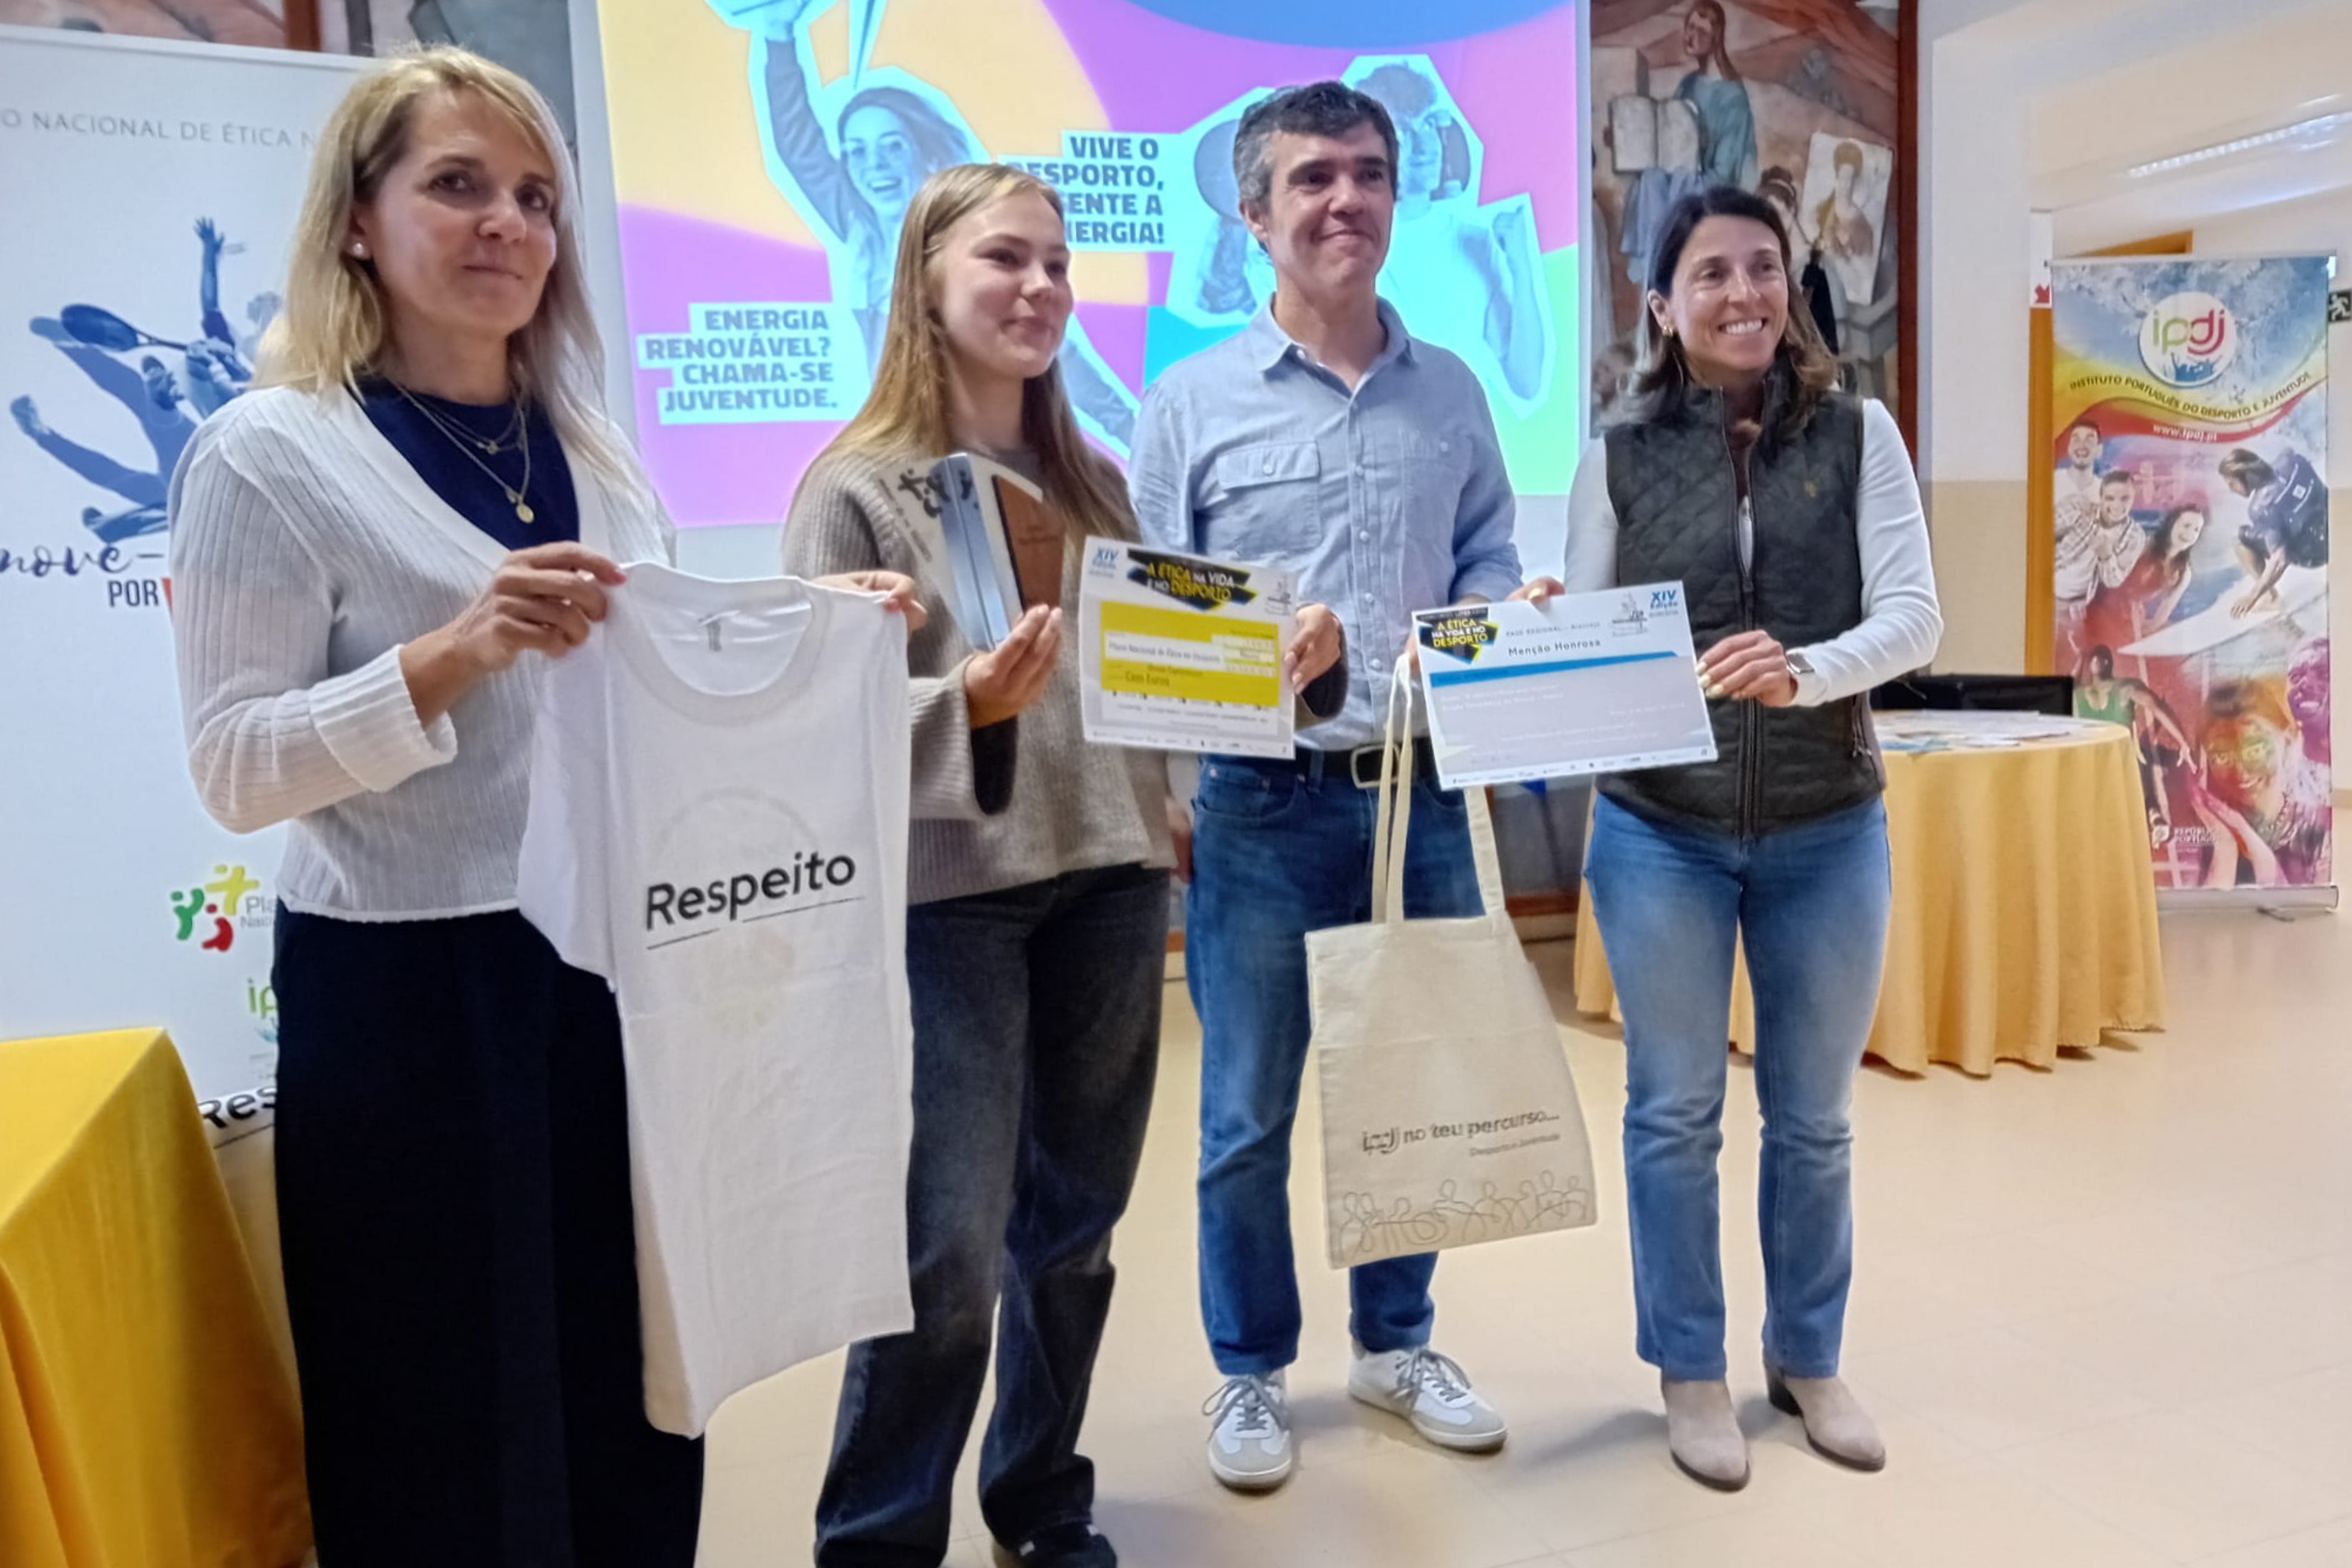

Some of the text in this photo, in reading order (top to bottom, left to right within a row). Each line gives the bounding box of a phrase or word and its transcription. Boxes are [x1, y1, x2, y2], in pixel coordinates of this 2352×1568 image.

[32, 111, 170, 140] NACIONAL
[181, 121, 212, 142] DE
[223, 122, 292, 147] ÉTICA
[1070, 136, 1159, 160] VIVE O
[1145, 194, 1163, 216] A
[704, 310, 829, 331] ENERGIA
[2152, 309, 2226, 355] ipdj
[645, 332, 831, 360] RENOVÁVEL?
[683, 362, 834, 385] CHAMA-SE
[665, 388, 838, 413] JUVENTUDE.
[2070, 371, 2310, 420] INSTITUTO PORTUGUÊS DO DESPORTO E JUVENTUDE
[2152, 424, 2218, 442] www.ipdj.pt
[1208, 571, 1234, 587] VIDA
[108, 579, 159, 608] POR
[1651, 590, 1677, 602] XIV
[1437, 622, 1445, 631] A
[1434, 632, 1488, 648] DESPORTO
[1508, 639, 1602, 656] Menção Honrosa
[646, 851, 856, 931] Respeito
[1404, 1127, 1426, 1144] no
[1431, 1122, 1462, 1139] teu
